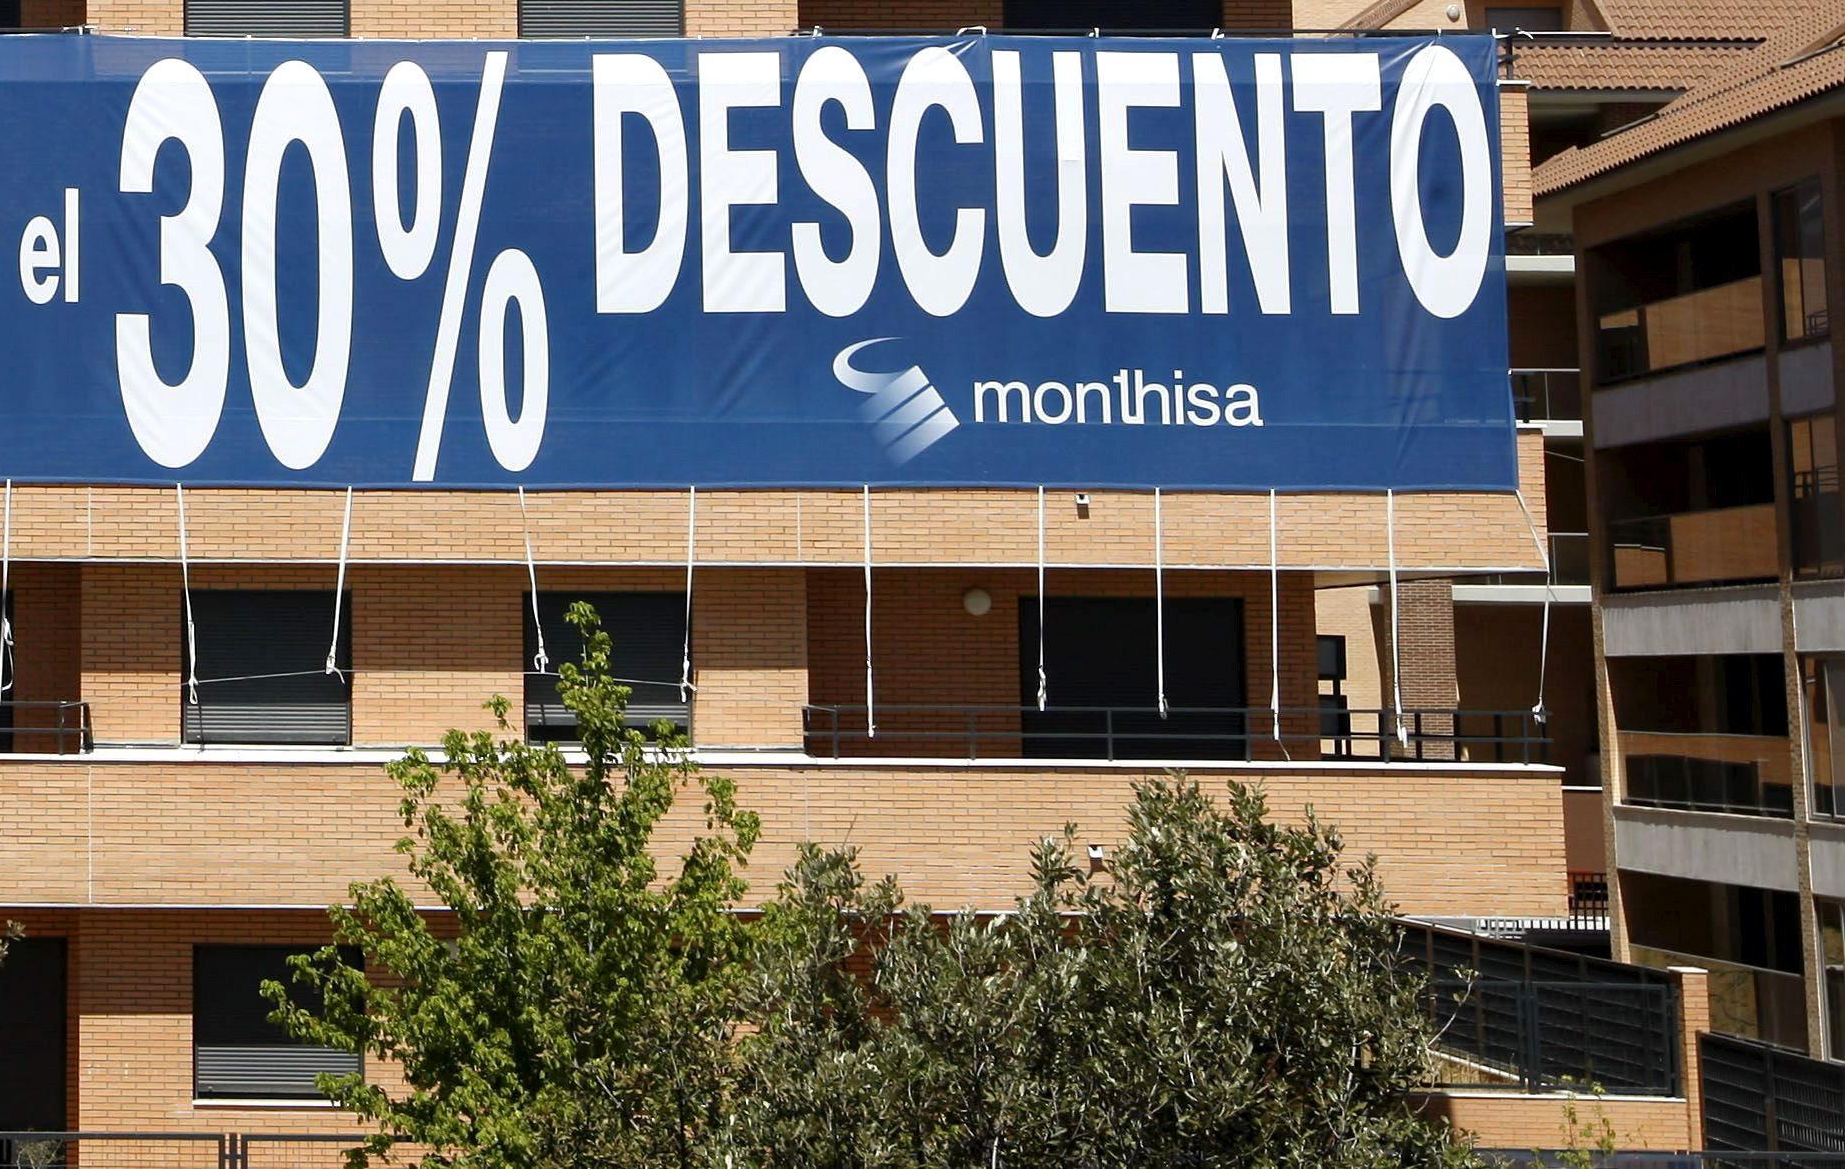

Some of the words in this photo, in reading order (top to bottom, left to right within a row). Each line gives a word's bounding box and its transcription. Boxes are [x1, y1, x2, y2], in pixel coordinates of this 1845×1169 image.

[18, 186, 80, 306] el
[114, 50, 550, 483] 30%
[591, 39, 1493, 320] DESCUENTO
[973, 368, 1265, 428] monthisa
